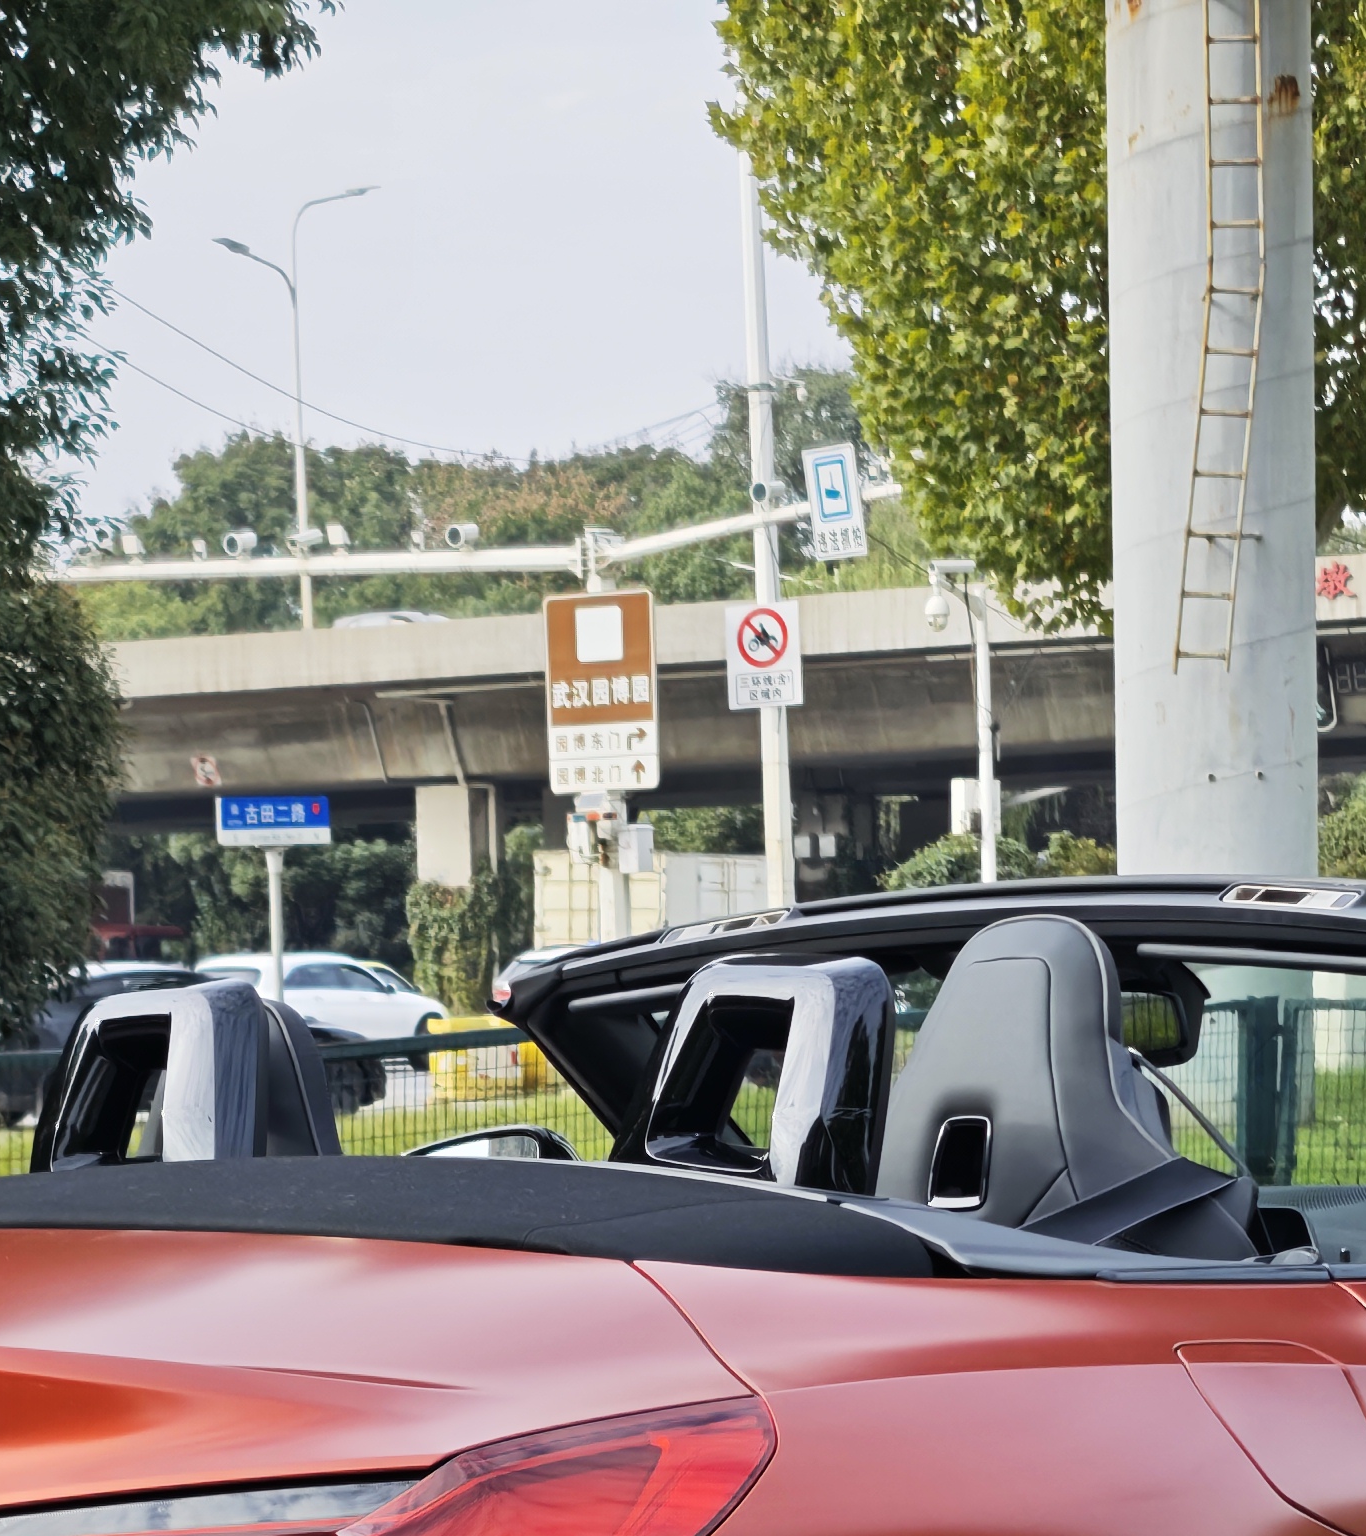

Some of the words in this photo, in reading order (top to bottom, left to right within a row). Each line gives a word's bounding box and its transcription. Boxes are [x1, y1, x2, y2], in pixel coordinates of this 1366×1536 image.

[552, 674, 650, 709] 武汉园博园
[244, 802, 306, 825] 古田二路
